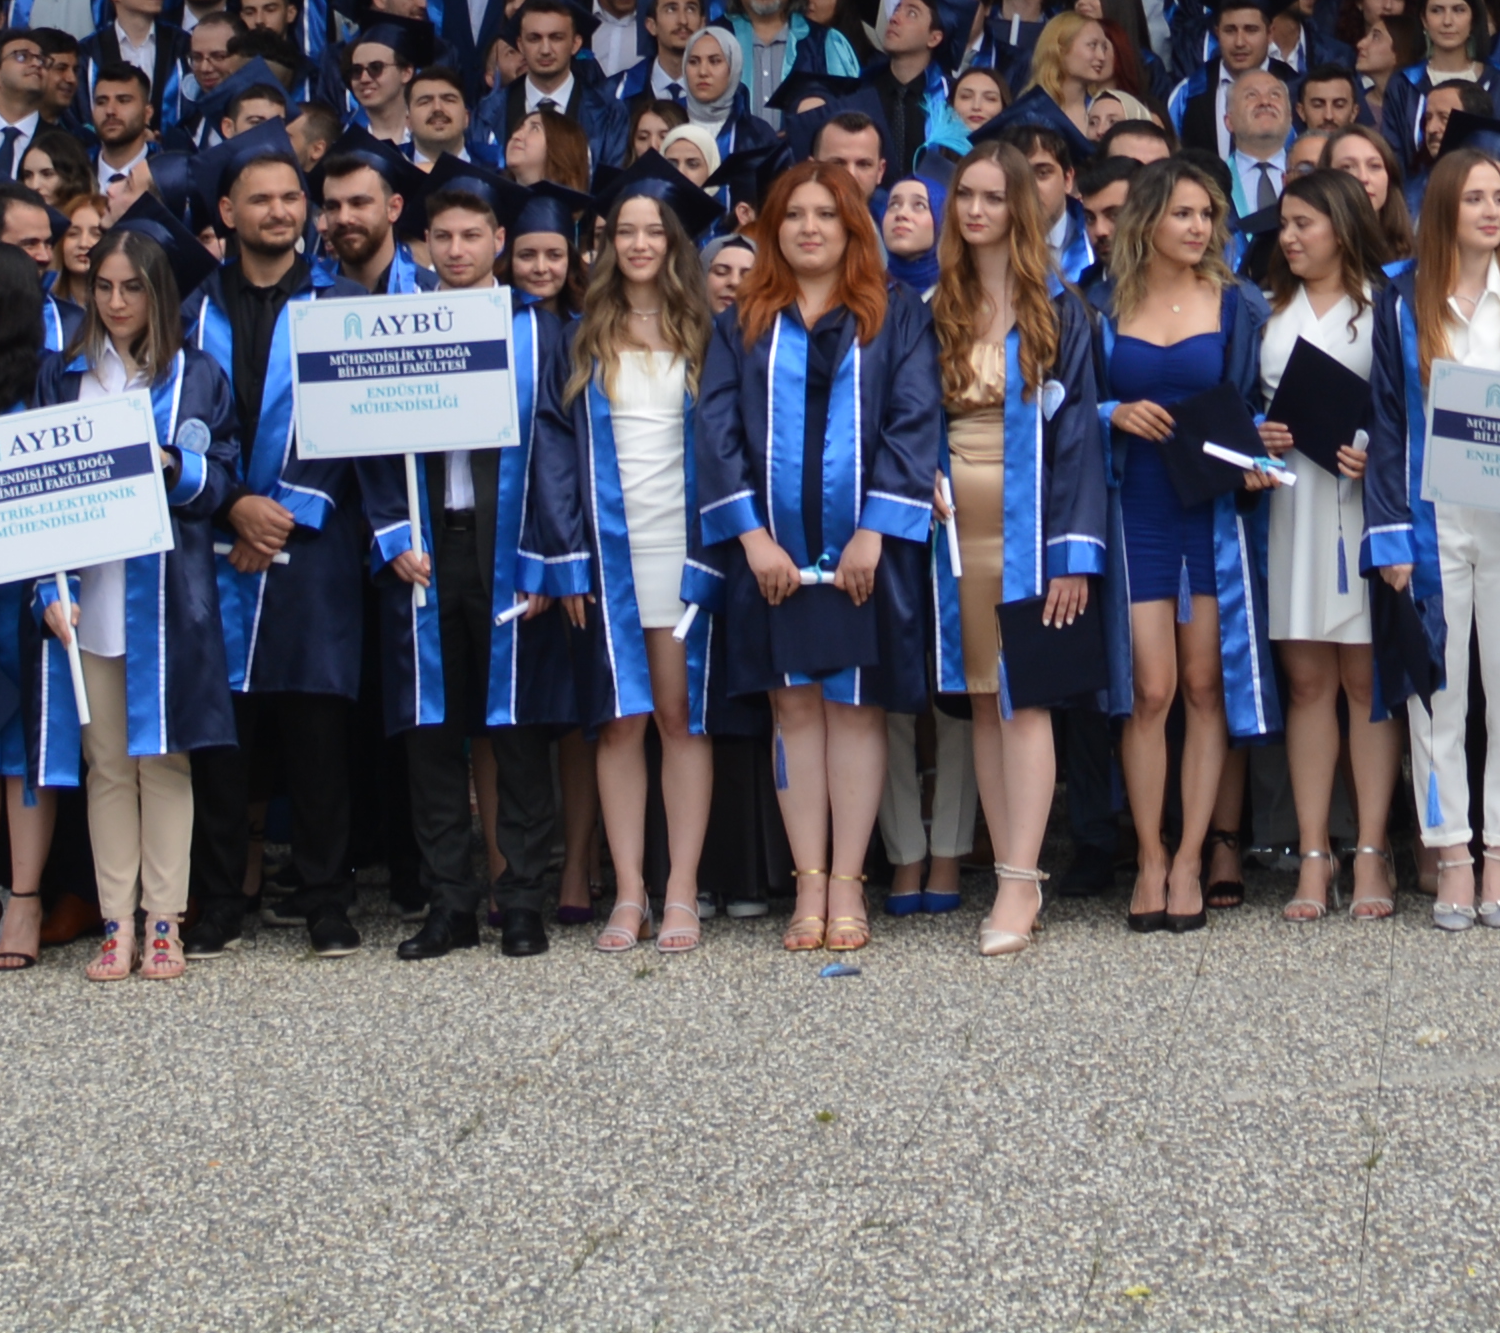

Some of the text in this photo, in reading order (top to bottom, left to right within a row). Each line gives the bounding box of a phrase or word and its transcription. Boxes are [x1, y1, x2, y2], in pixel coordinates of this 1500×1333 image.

[370, 306, 454, 337] AYBÜ
[330, 345, 471, 366] MÜHENDİSLİK VE DOĞA
[338, 358, 467, 378] BİLİMLERİ FAKÜLTESİ
[367, 382, 440, 399] ENDÜSTRİ
[350, 396, 458, 414] MÜHENDİSLİĞİ
[9, 416, 94, 456] AYBÜ
[59, 461, 76, 475] VE
[79, 454, 115, 472] DOĞA
[46, 468, 112, 492] FAKÜLTESİ
